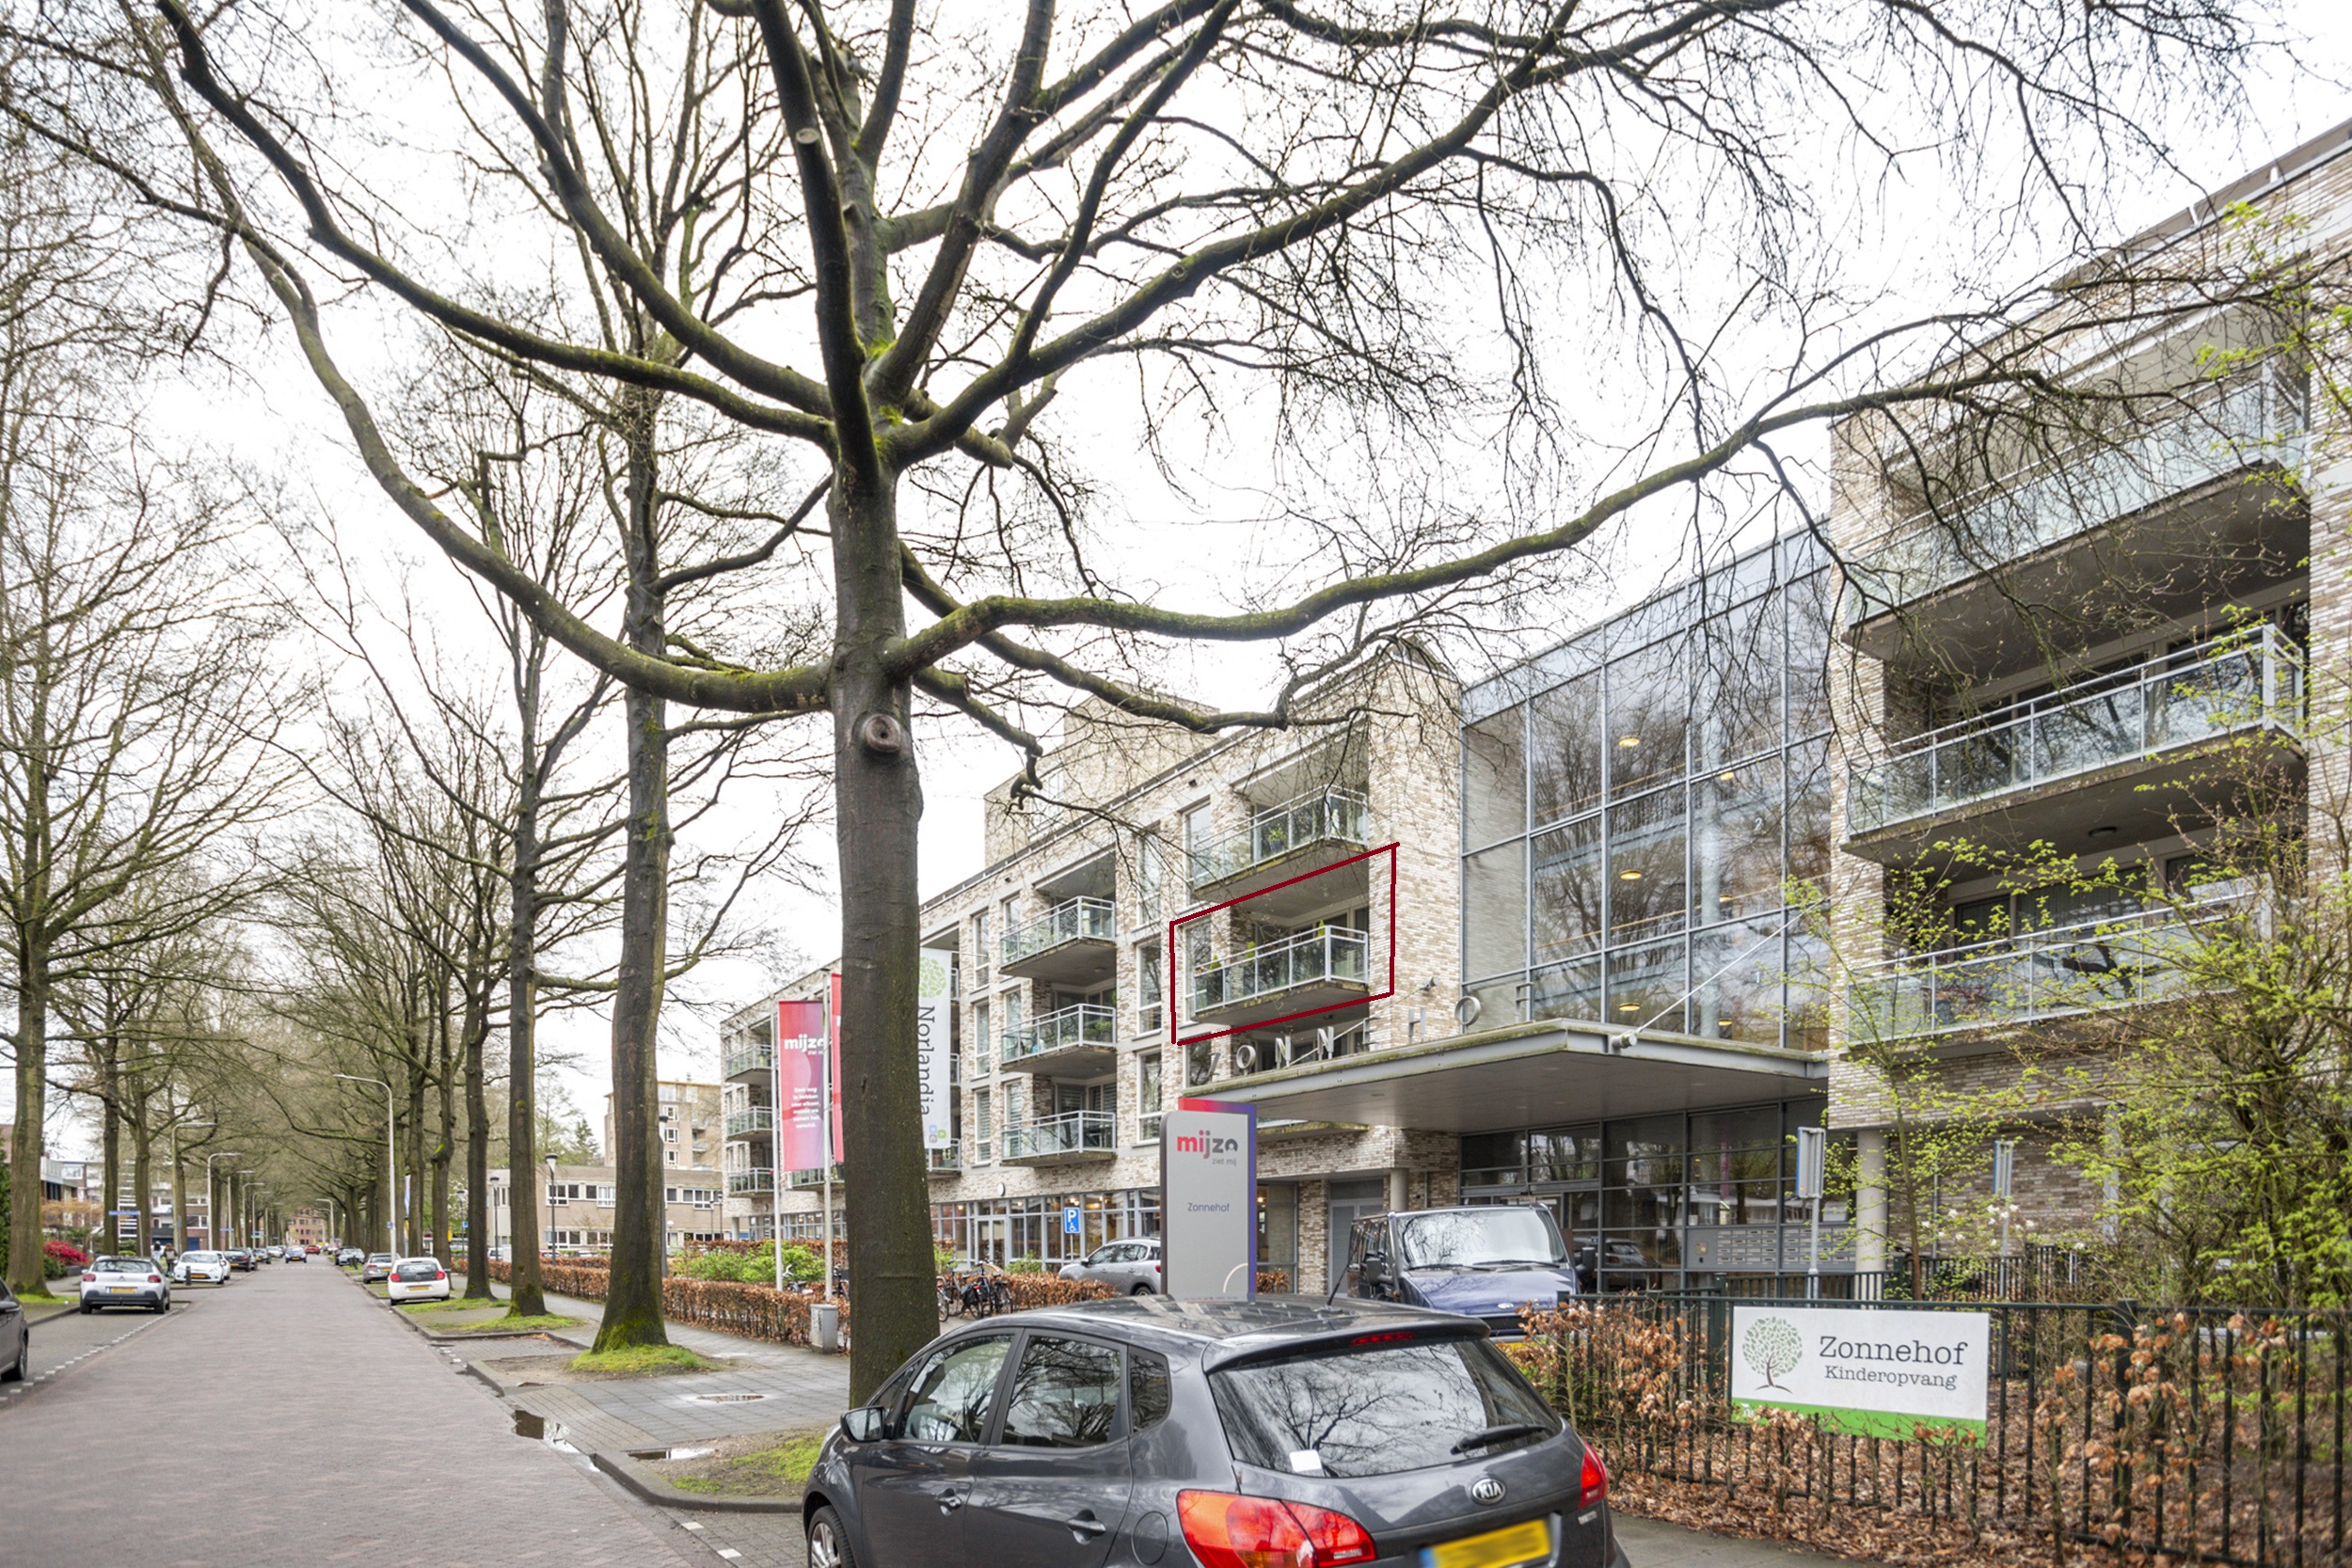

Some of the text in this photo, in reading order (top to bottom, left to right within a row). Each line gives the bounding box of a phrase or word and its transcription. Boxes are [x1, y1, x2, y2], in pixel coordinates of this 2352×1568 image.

[917, 1006, 935, 1116] Norlandia
[1177, 1130, 1238, 1159] mijzo
[1226, 1158, 1237, 1167] mij
[1067, 1209, 1077, 1224] P
[1187, 1202, 1230, 1212] Zonnehof
[1820, 1336, 1968, 1366] Zonnehof
[1824, 1365, 1957, 1391] Kinderopvang
[1478, 1481, 1502, 1499] KIA
